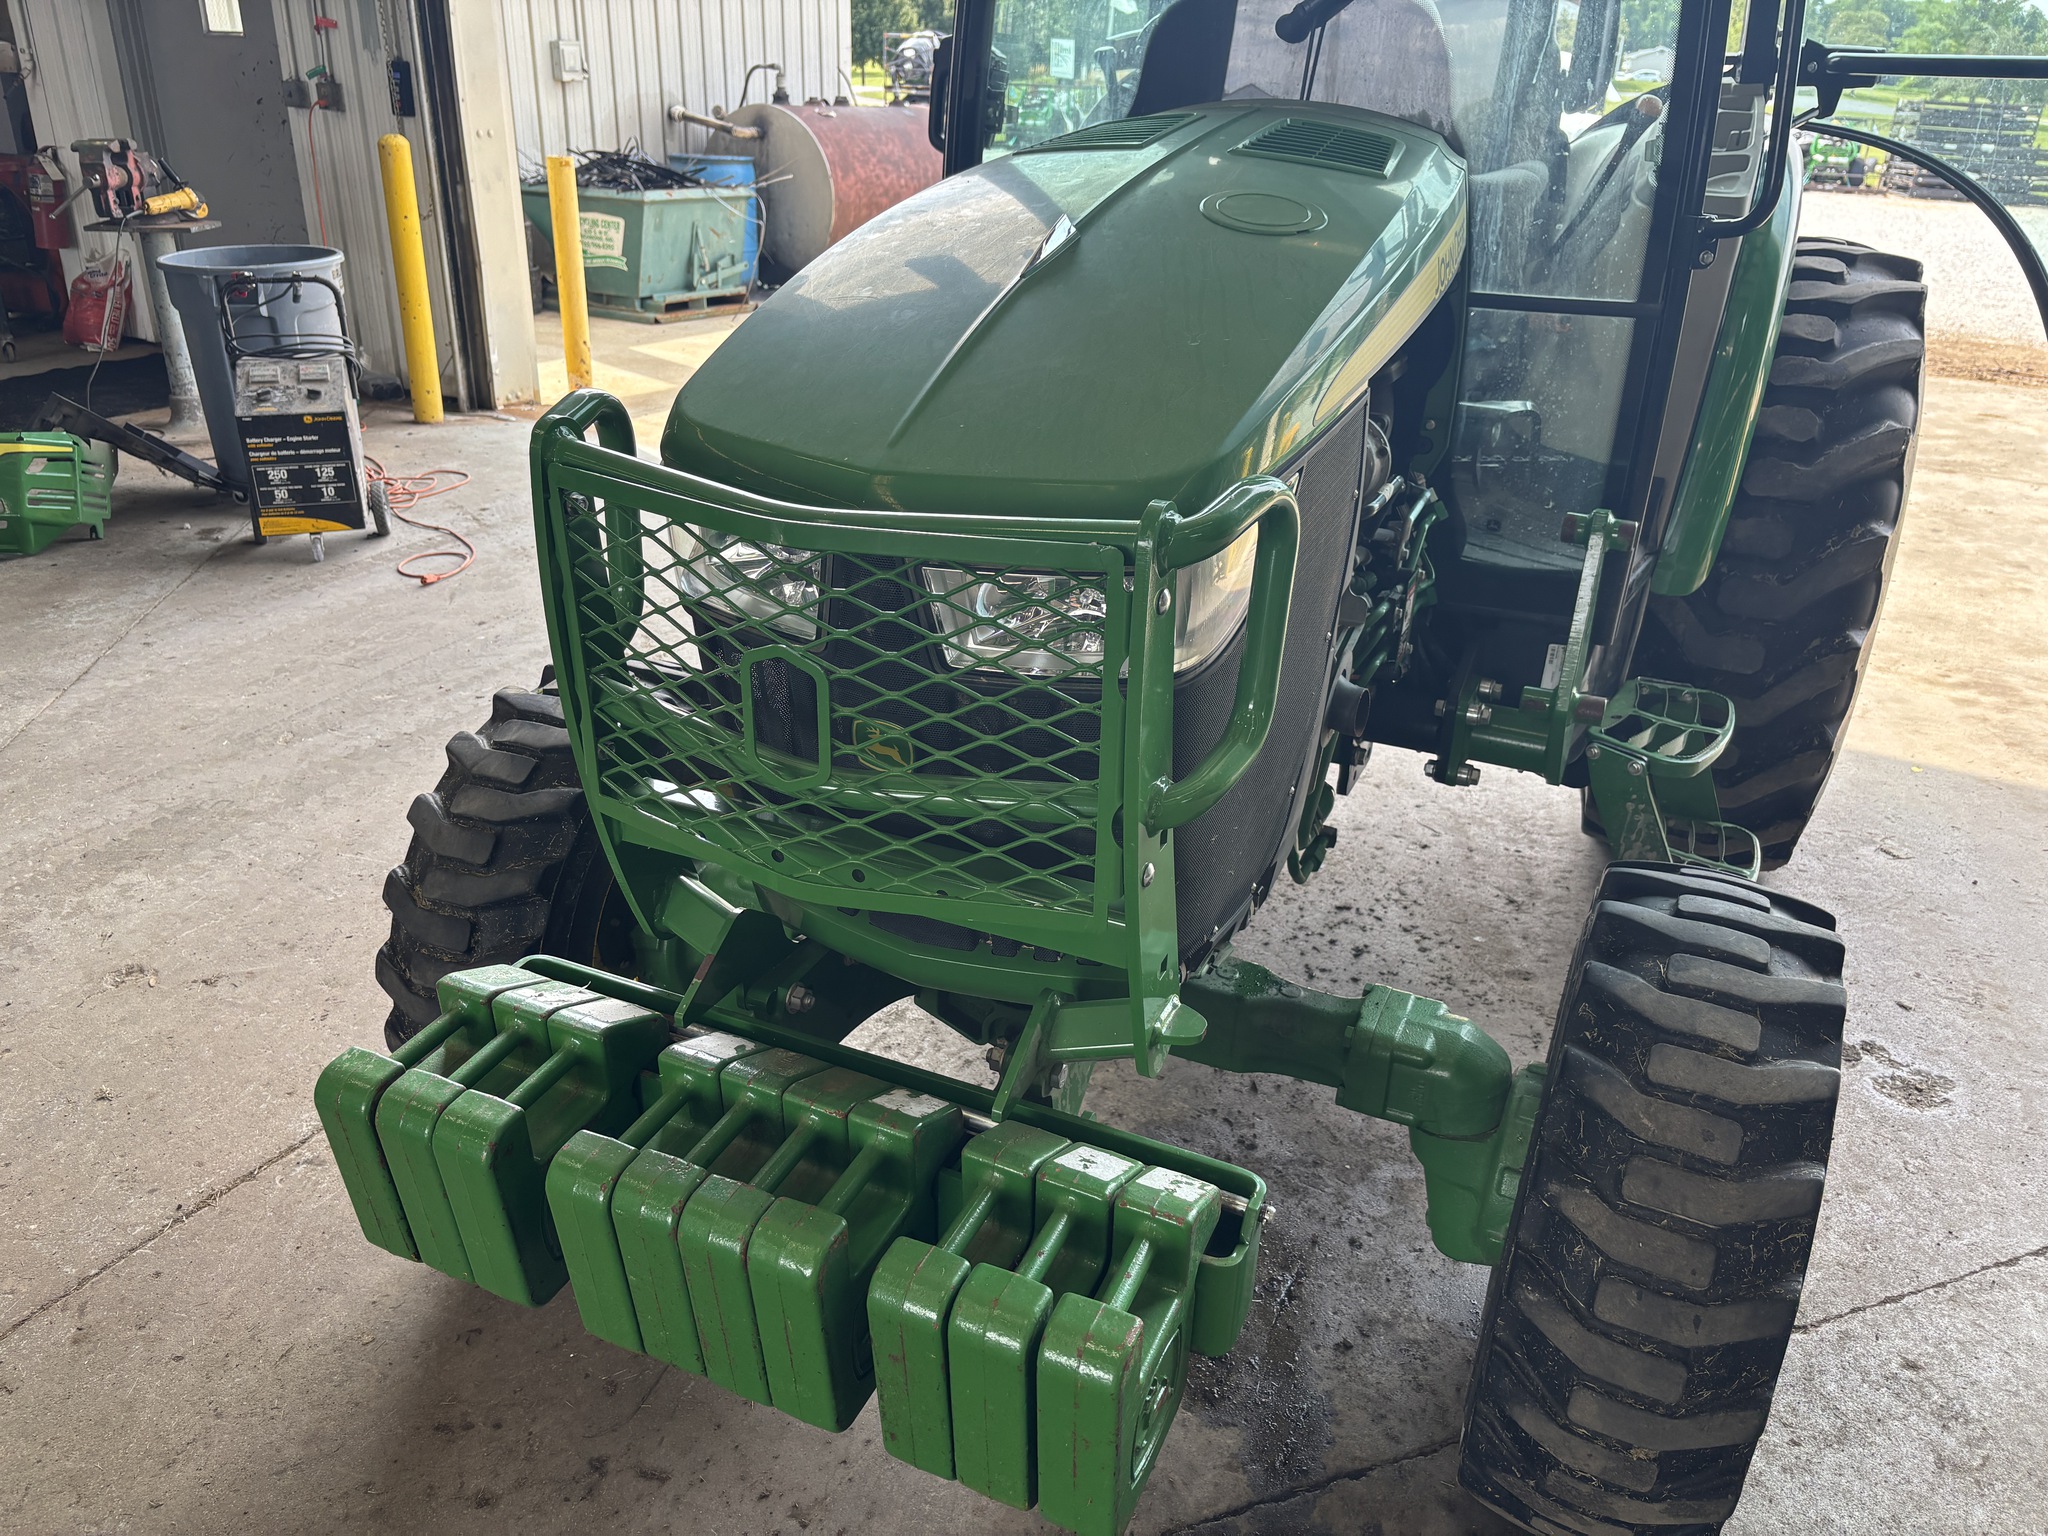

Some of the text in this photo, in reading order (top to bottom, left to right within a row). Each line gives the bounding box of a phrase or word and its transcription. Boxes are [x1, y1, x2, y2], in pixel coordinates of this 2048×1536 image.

[600, 219, 620, 233] CENTER
[267, 467, 335, 480] 250 125
[274, 487, 335, 499] 50 10
